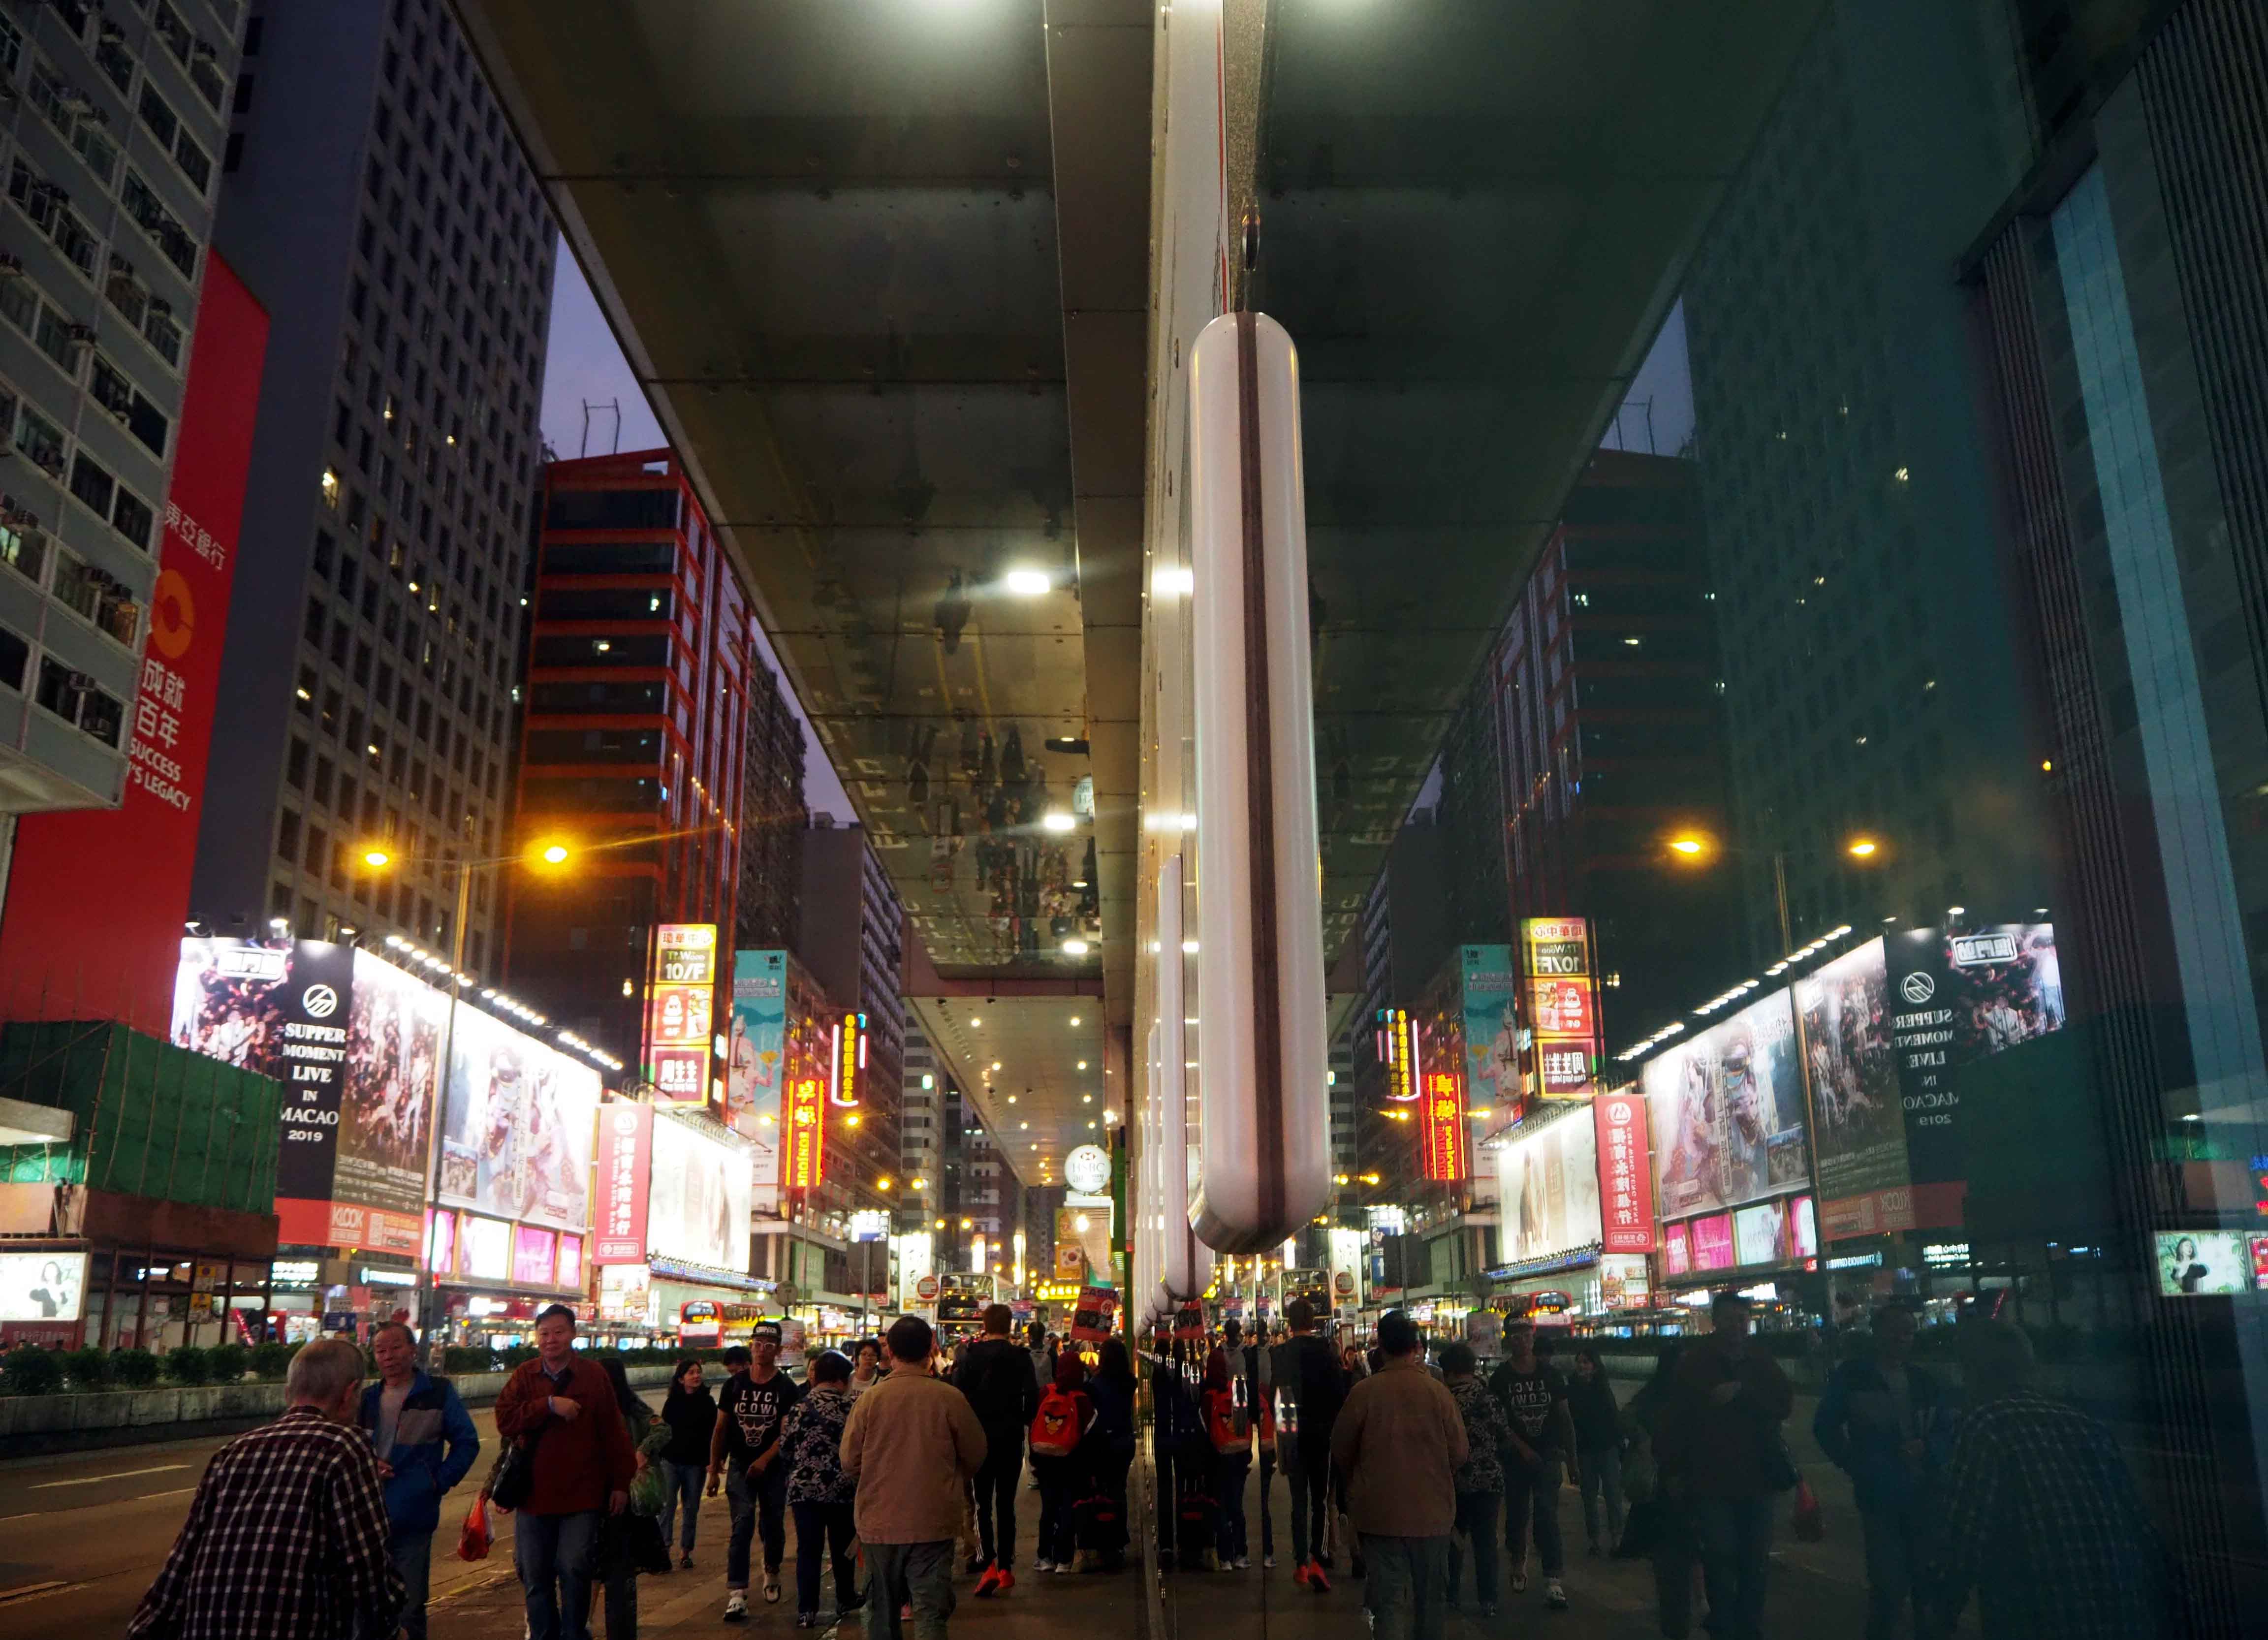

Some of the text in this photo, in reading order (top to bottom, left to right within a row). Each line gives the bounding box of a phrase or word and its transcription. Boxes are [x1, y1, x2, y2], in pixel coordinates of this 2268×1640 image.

[165, 500, 225, 570] 東亞銀行
[142, 658, 186, 713] 成就
[137, 695, 180, 749] 百年
[130, 737, 181, 782] SUCCESS
[144, 771, 191, 811] LEGACY
[665, 962, 705, 980] 10/F
[285, 1022, 346, 1043] SUPPER
[282, 1043, 346, 1062] MOMENT
[292, 1065, 332, 1083] LIVE
[302, 1089, 318, 1102] IN
[280, 1107, 339, 1125] MACAO
[288, 1130, 323, 1142] 2019
[1072, 1162, 1105, 1172] HSBC
[331, 1205, 363, 1229] KLOOK
